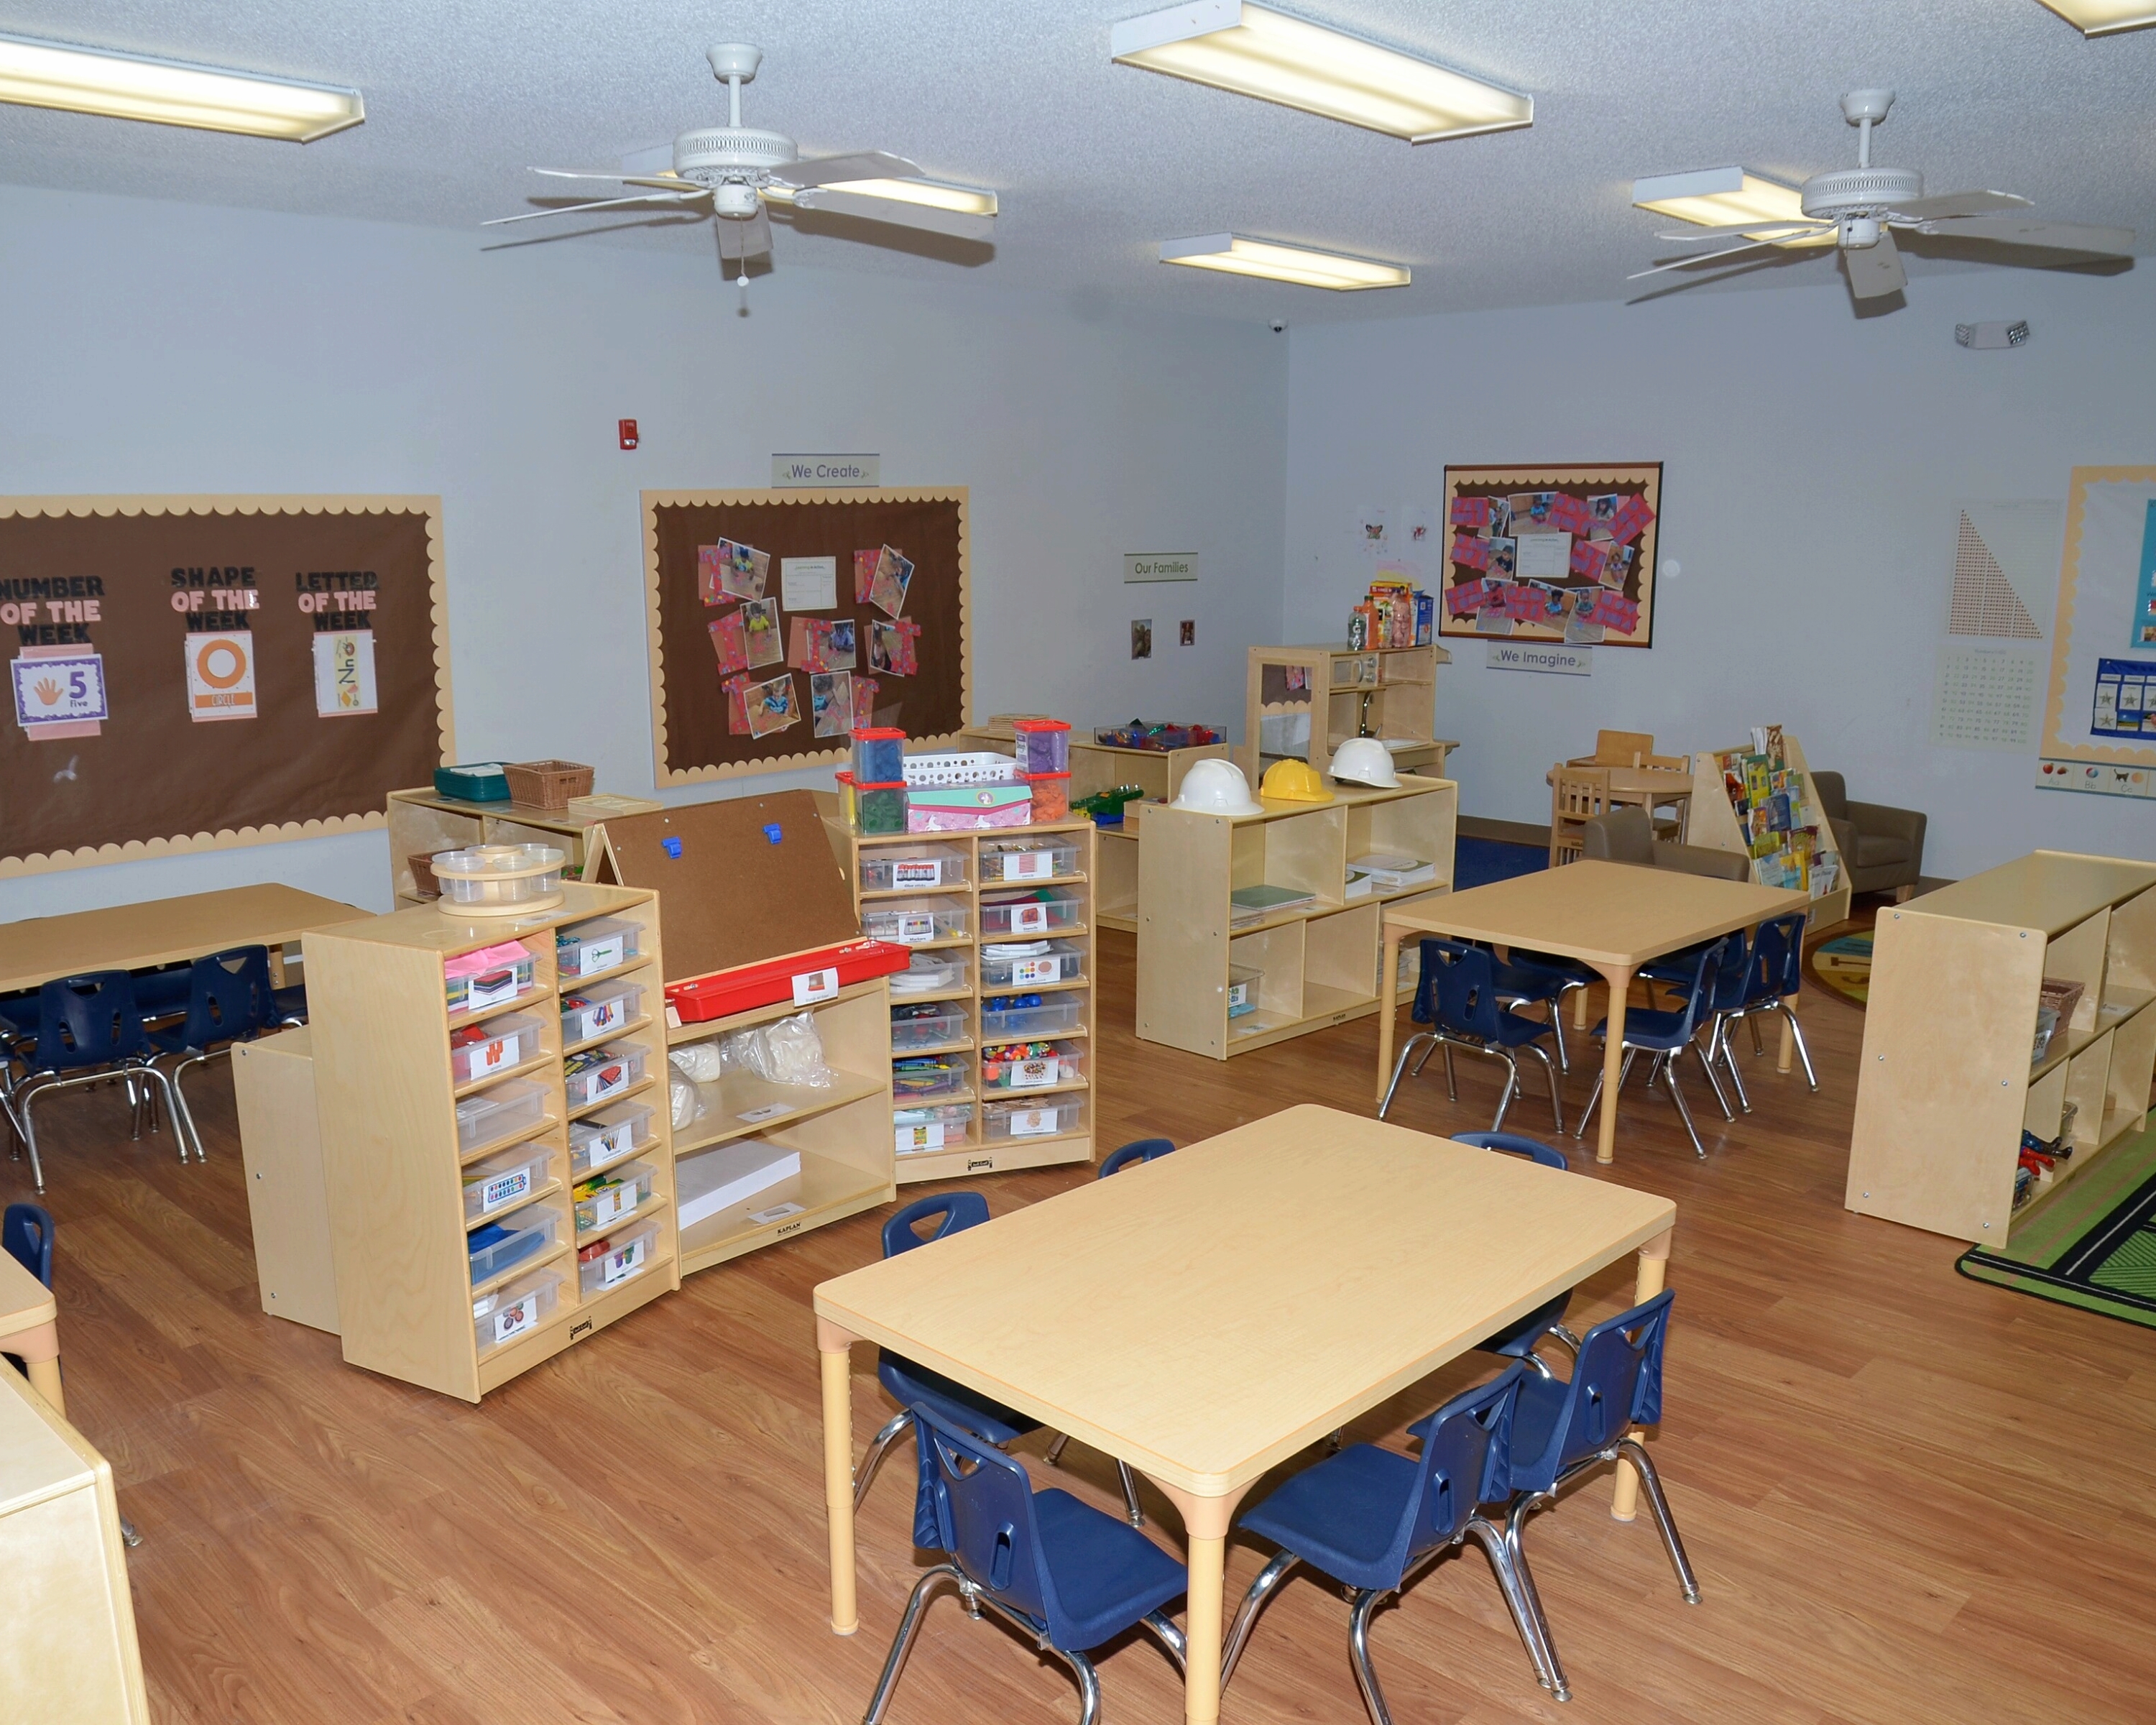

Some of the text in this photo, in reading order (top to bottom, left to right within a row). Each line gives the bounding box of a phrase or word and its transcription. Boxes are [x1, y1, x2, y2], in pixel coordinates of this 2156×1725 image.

[792, 464, 860, 478] We Create
[170, 566, 256, 588] SHAPE
[1135, 561, 1189, 574] Our Families
[0, 576, 105, 600] NUMBER
[295, 571, 379, 592] LETTER
[171, 589, 259, 612] OF THE
[298, 590, 377, 613] OF THE
[0, 599, 101, 625] OF THE
[185, 611, 251, 631] WEEK
[313, 611, 372, 631] WEEK
[18, 623, 92, 646] WEEK
[1353, 625, 1361, 634] G
[1501, 650, 1576, 668] We Imagine
[338, 658, 356, 684] Nn
[69, 671, 87, 699] 5
[211, 694, 235, 707] CIRCLE
[2121, 783, 2132, 793] Cc
[778, 1222, 801, 1234] KAPLAN
